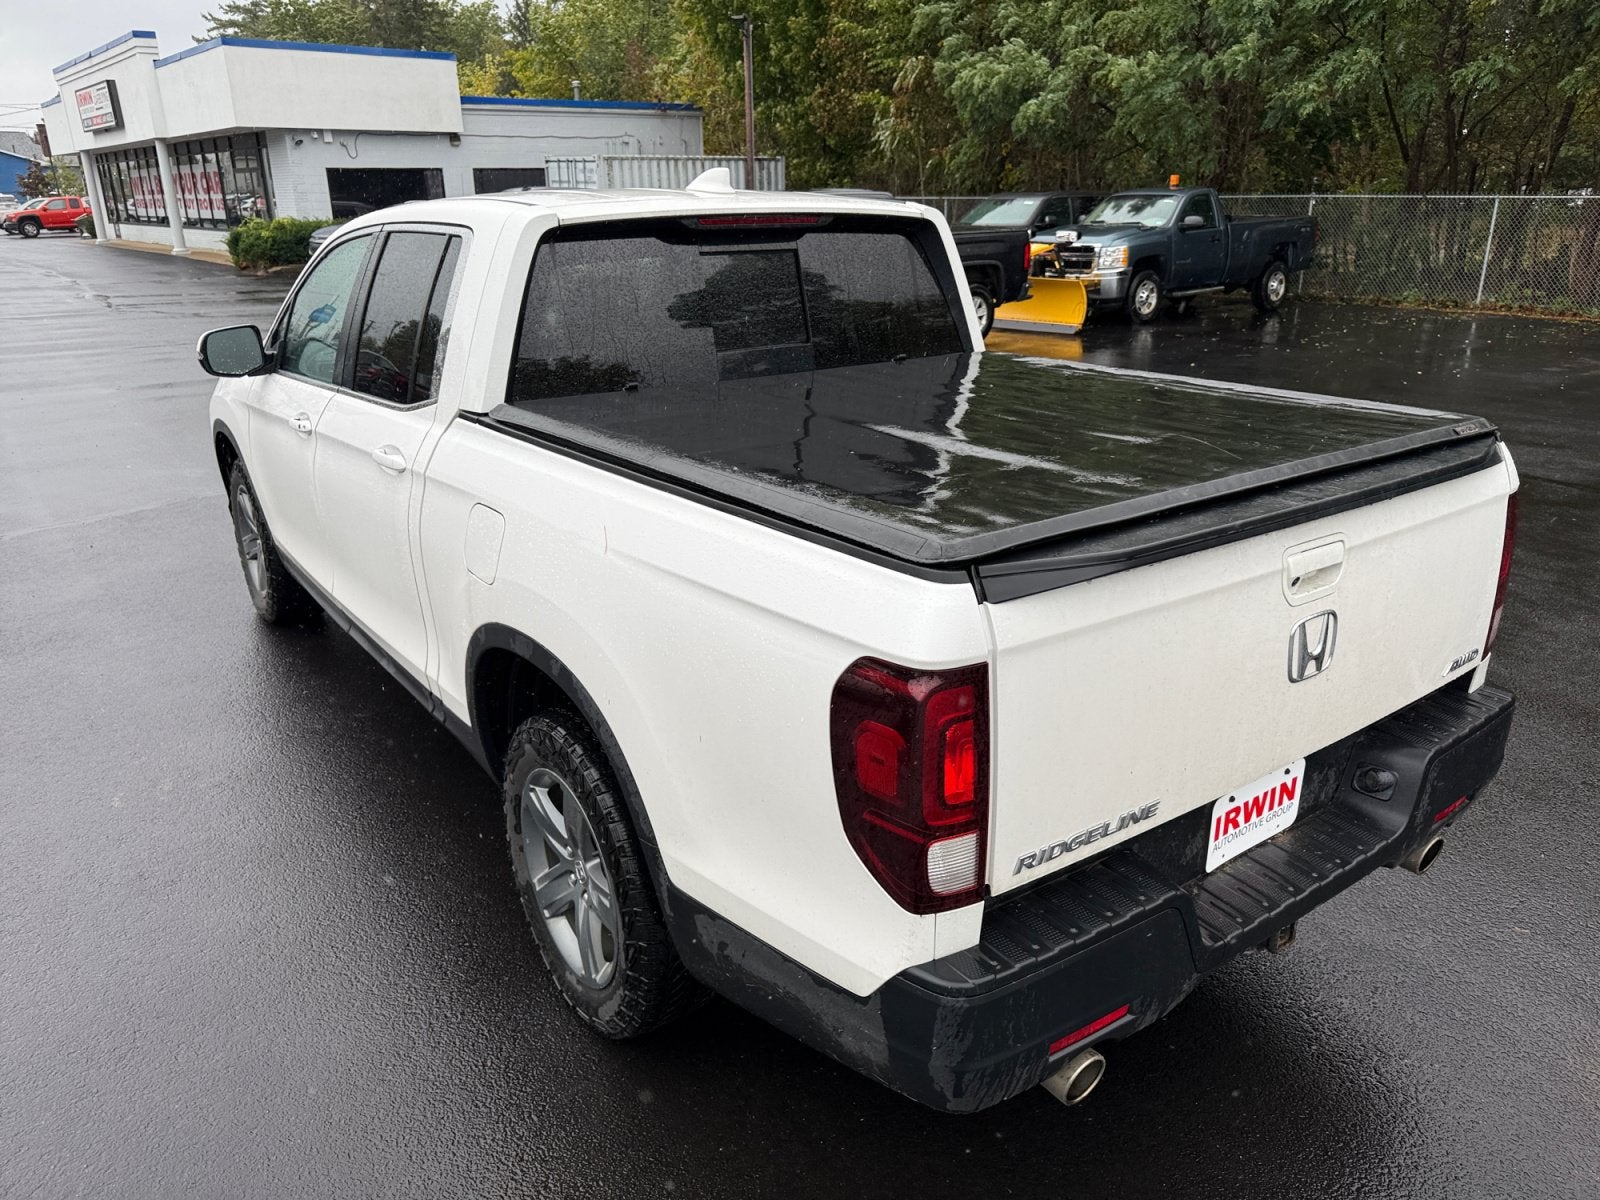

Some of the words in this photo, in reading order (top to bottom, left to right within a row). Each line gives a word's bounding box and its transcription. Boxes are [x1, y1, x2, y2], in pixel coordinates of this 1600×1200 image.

[1012, 798, 1161, 876] RIDGELINE
[1212, 816, 1264, 853] AUTOMOTIVE
[1265, 801, 1294, 823] GROUP
[1213, 776, 1298, 843] IRWIN
